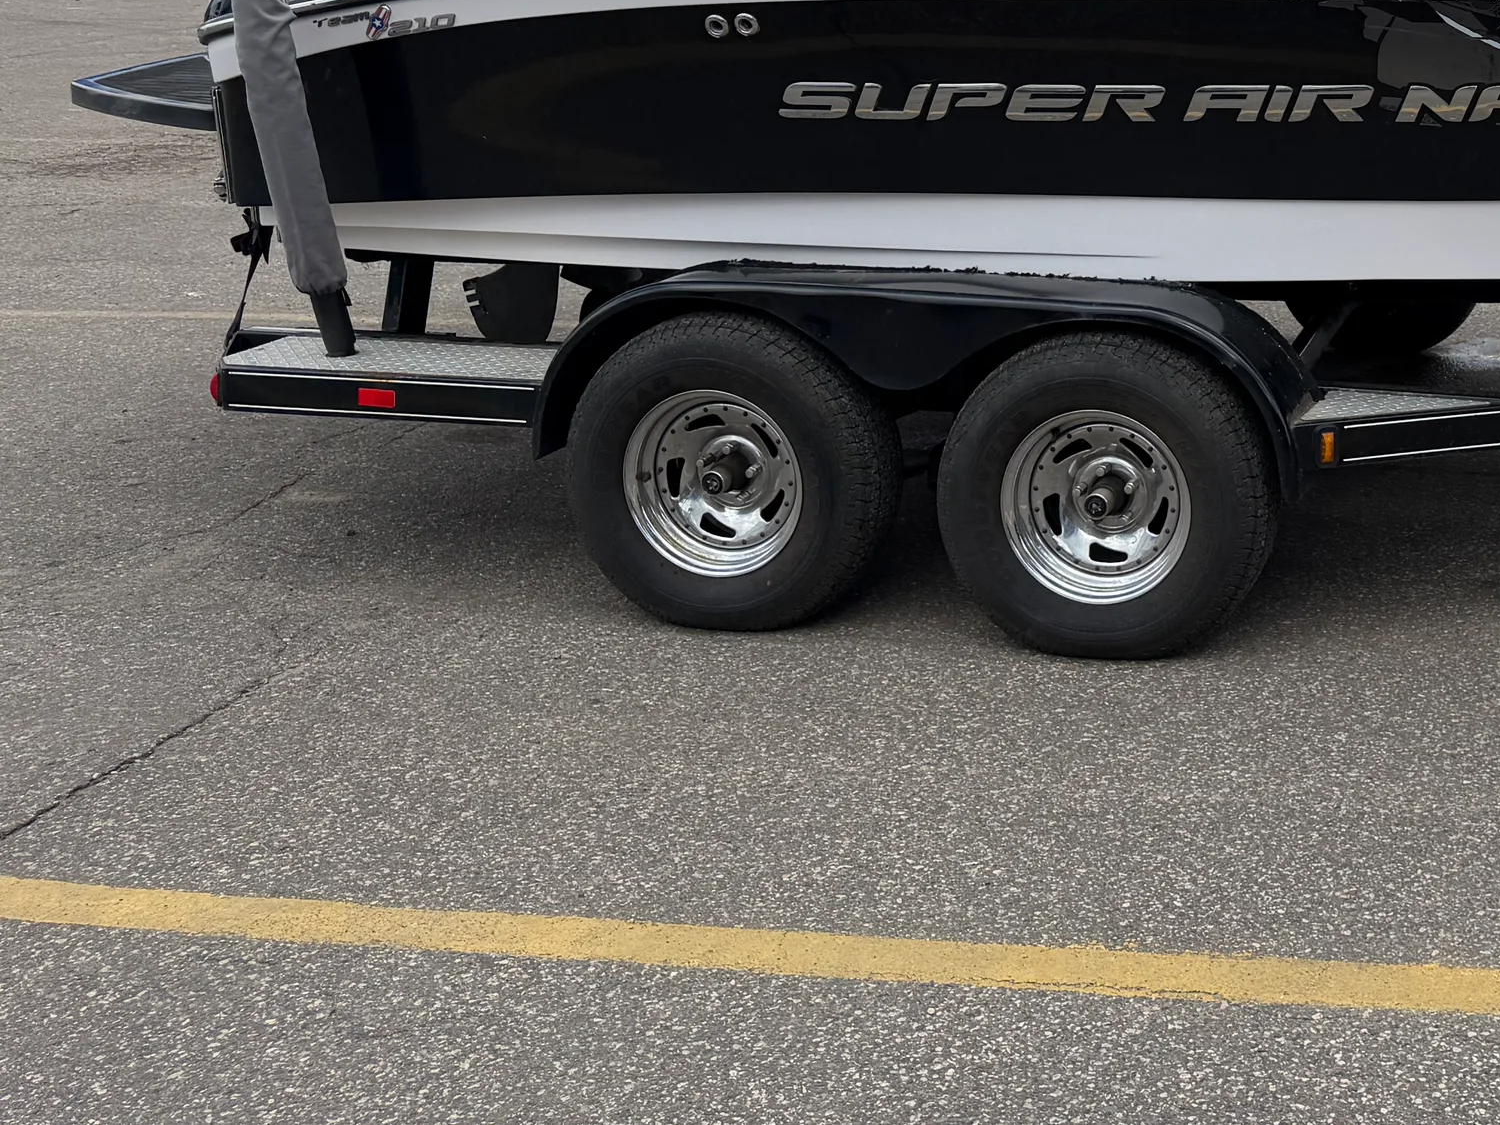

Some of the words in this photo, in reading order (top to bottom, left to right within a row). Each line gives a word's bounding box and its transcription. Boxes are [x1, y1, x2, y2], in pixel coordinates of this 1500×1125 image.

[387, 13, 456, 37] 210
[778, 82, 1166, 122] SUPER
[1183, 84, 1375, 122] AIR
